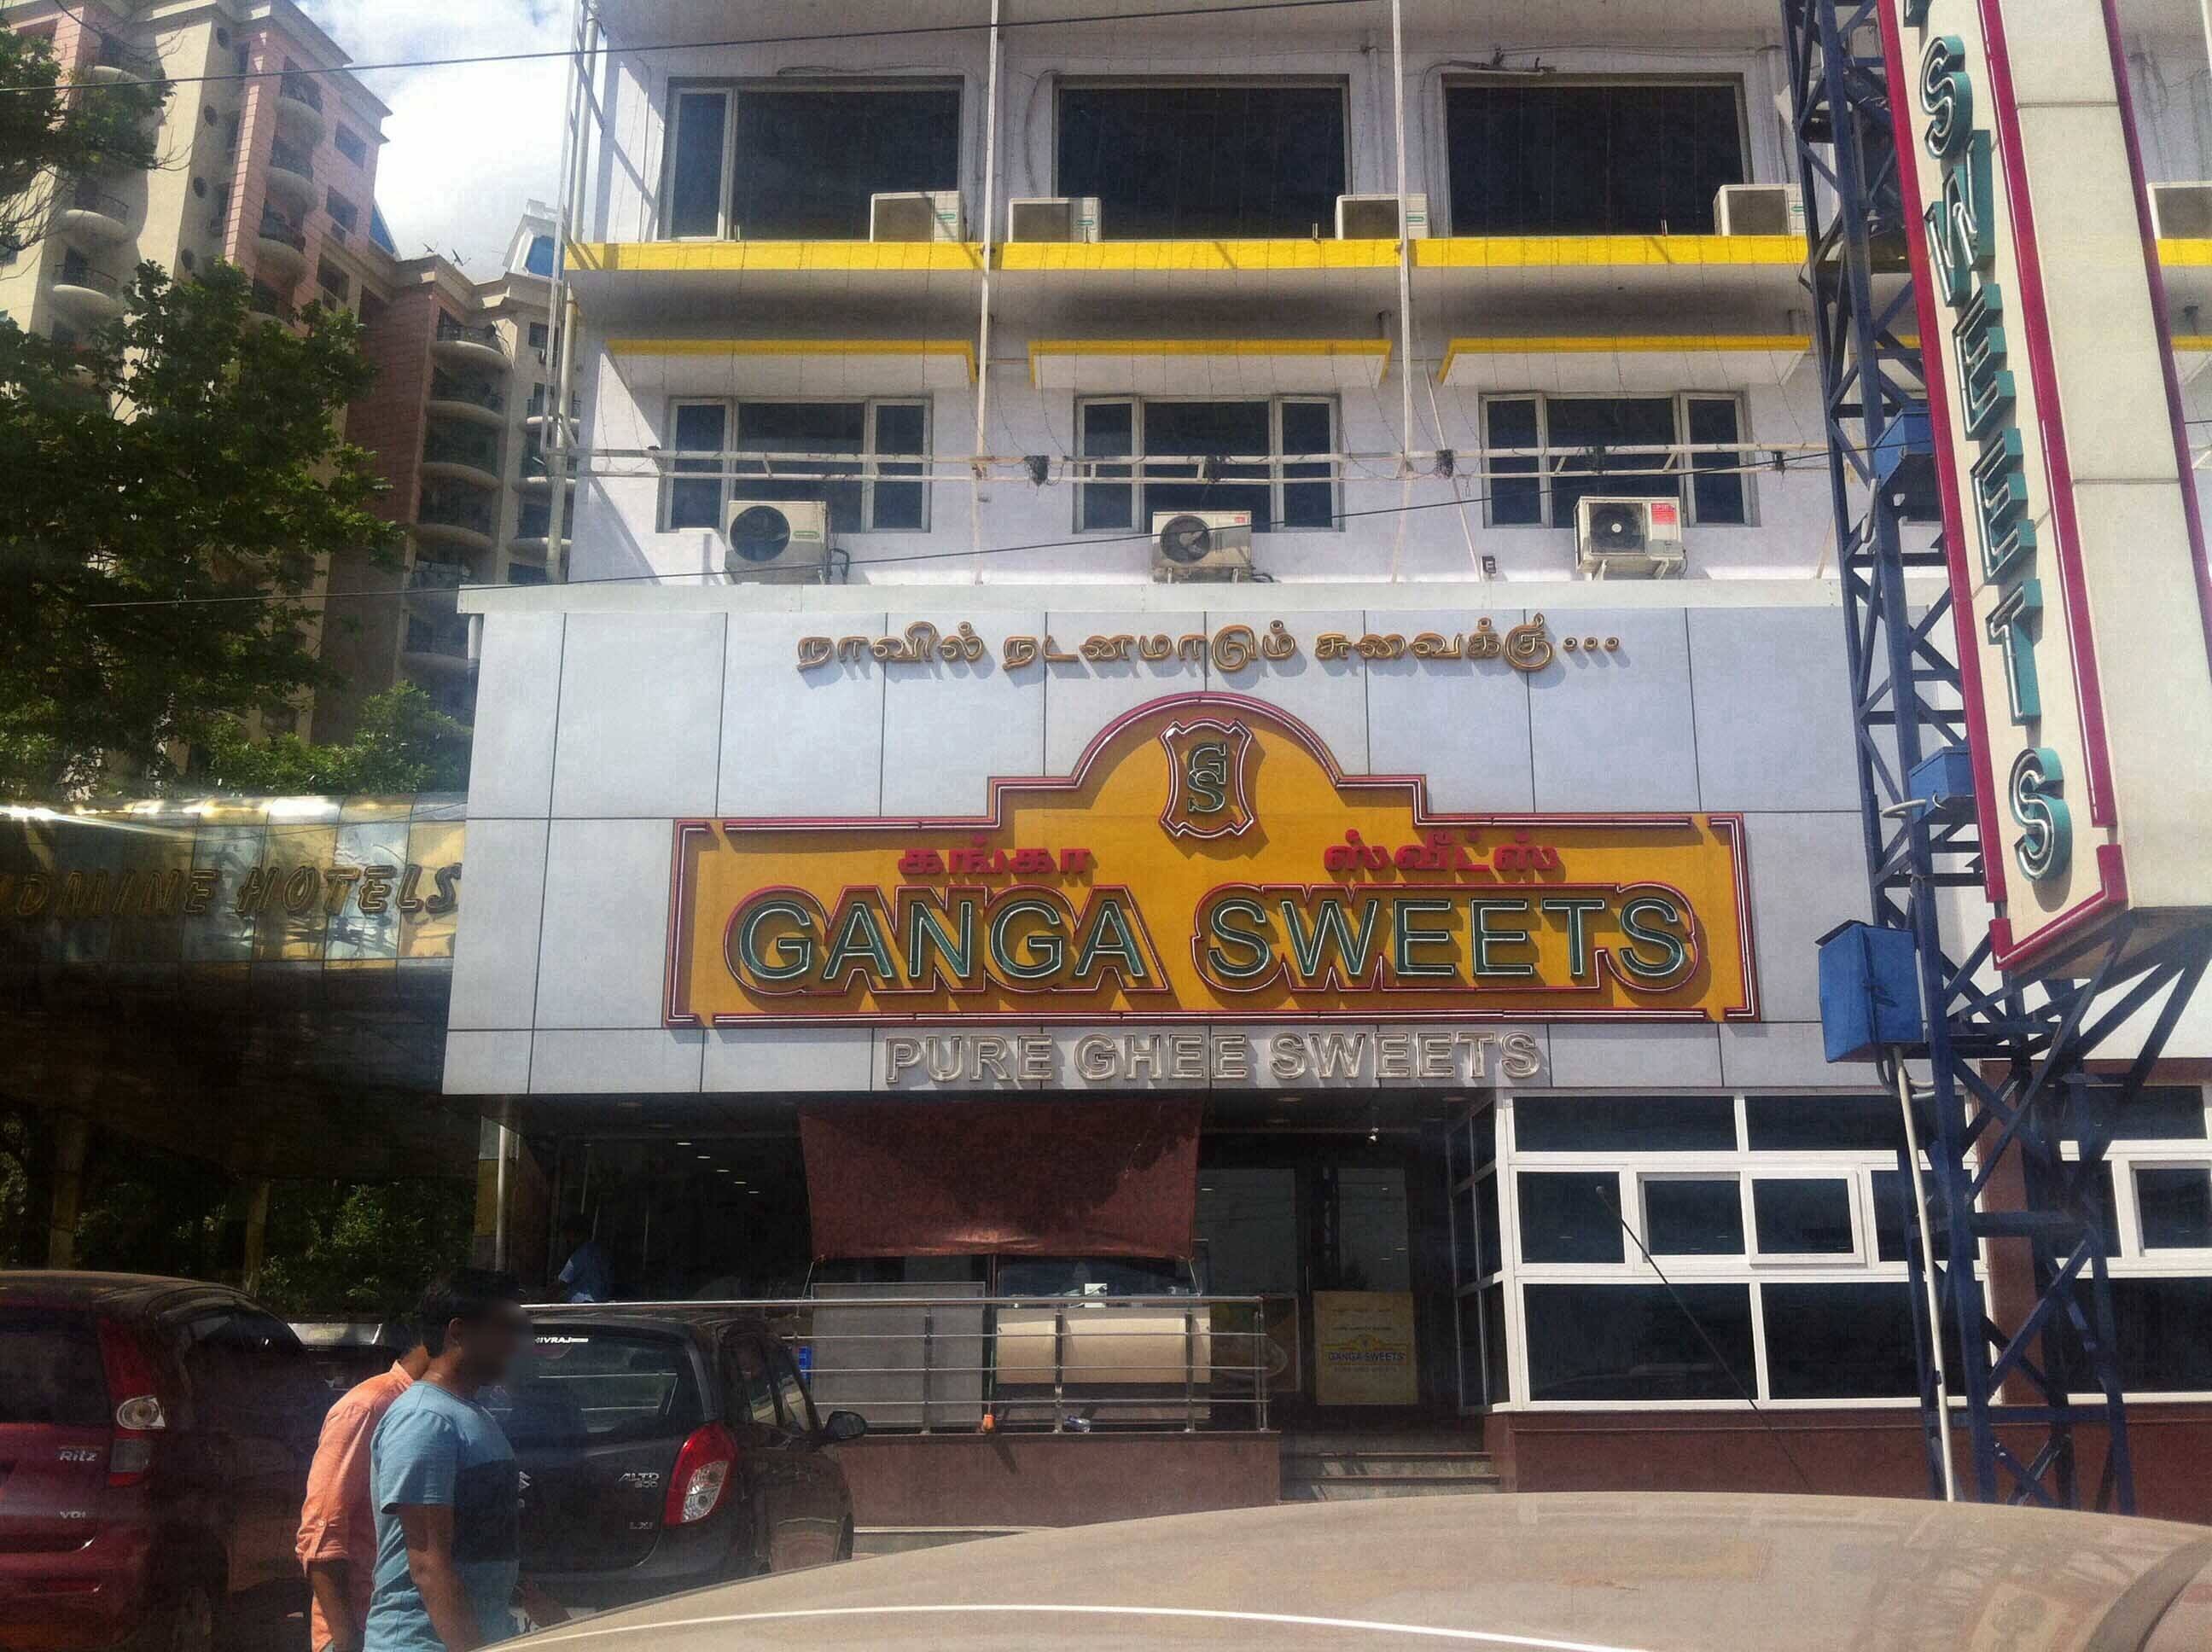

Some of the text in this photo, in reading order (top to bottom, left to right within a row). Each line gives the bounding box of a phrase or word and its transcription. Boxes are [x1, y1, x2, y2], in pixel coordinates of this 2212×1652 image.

[1920, 34, 2074, 882] SWEETS
[797, 620, 985, 671] நாவில்
[1002, 618, 1296, 672] நடனமாடும்
[898, 829, 1559, 875] கங்கா ஸ்வீட்ஸ்
[234, 862, 463, 916] HOTELS
[736, 896, 1688, 982] GANGA SWEETS
[885, 1031, 1540, 1084] PURE GHEE SWEETS
[59, 1450, 96, 1462] Ritz
[619, 1472, 661, 1482] ALTO
